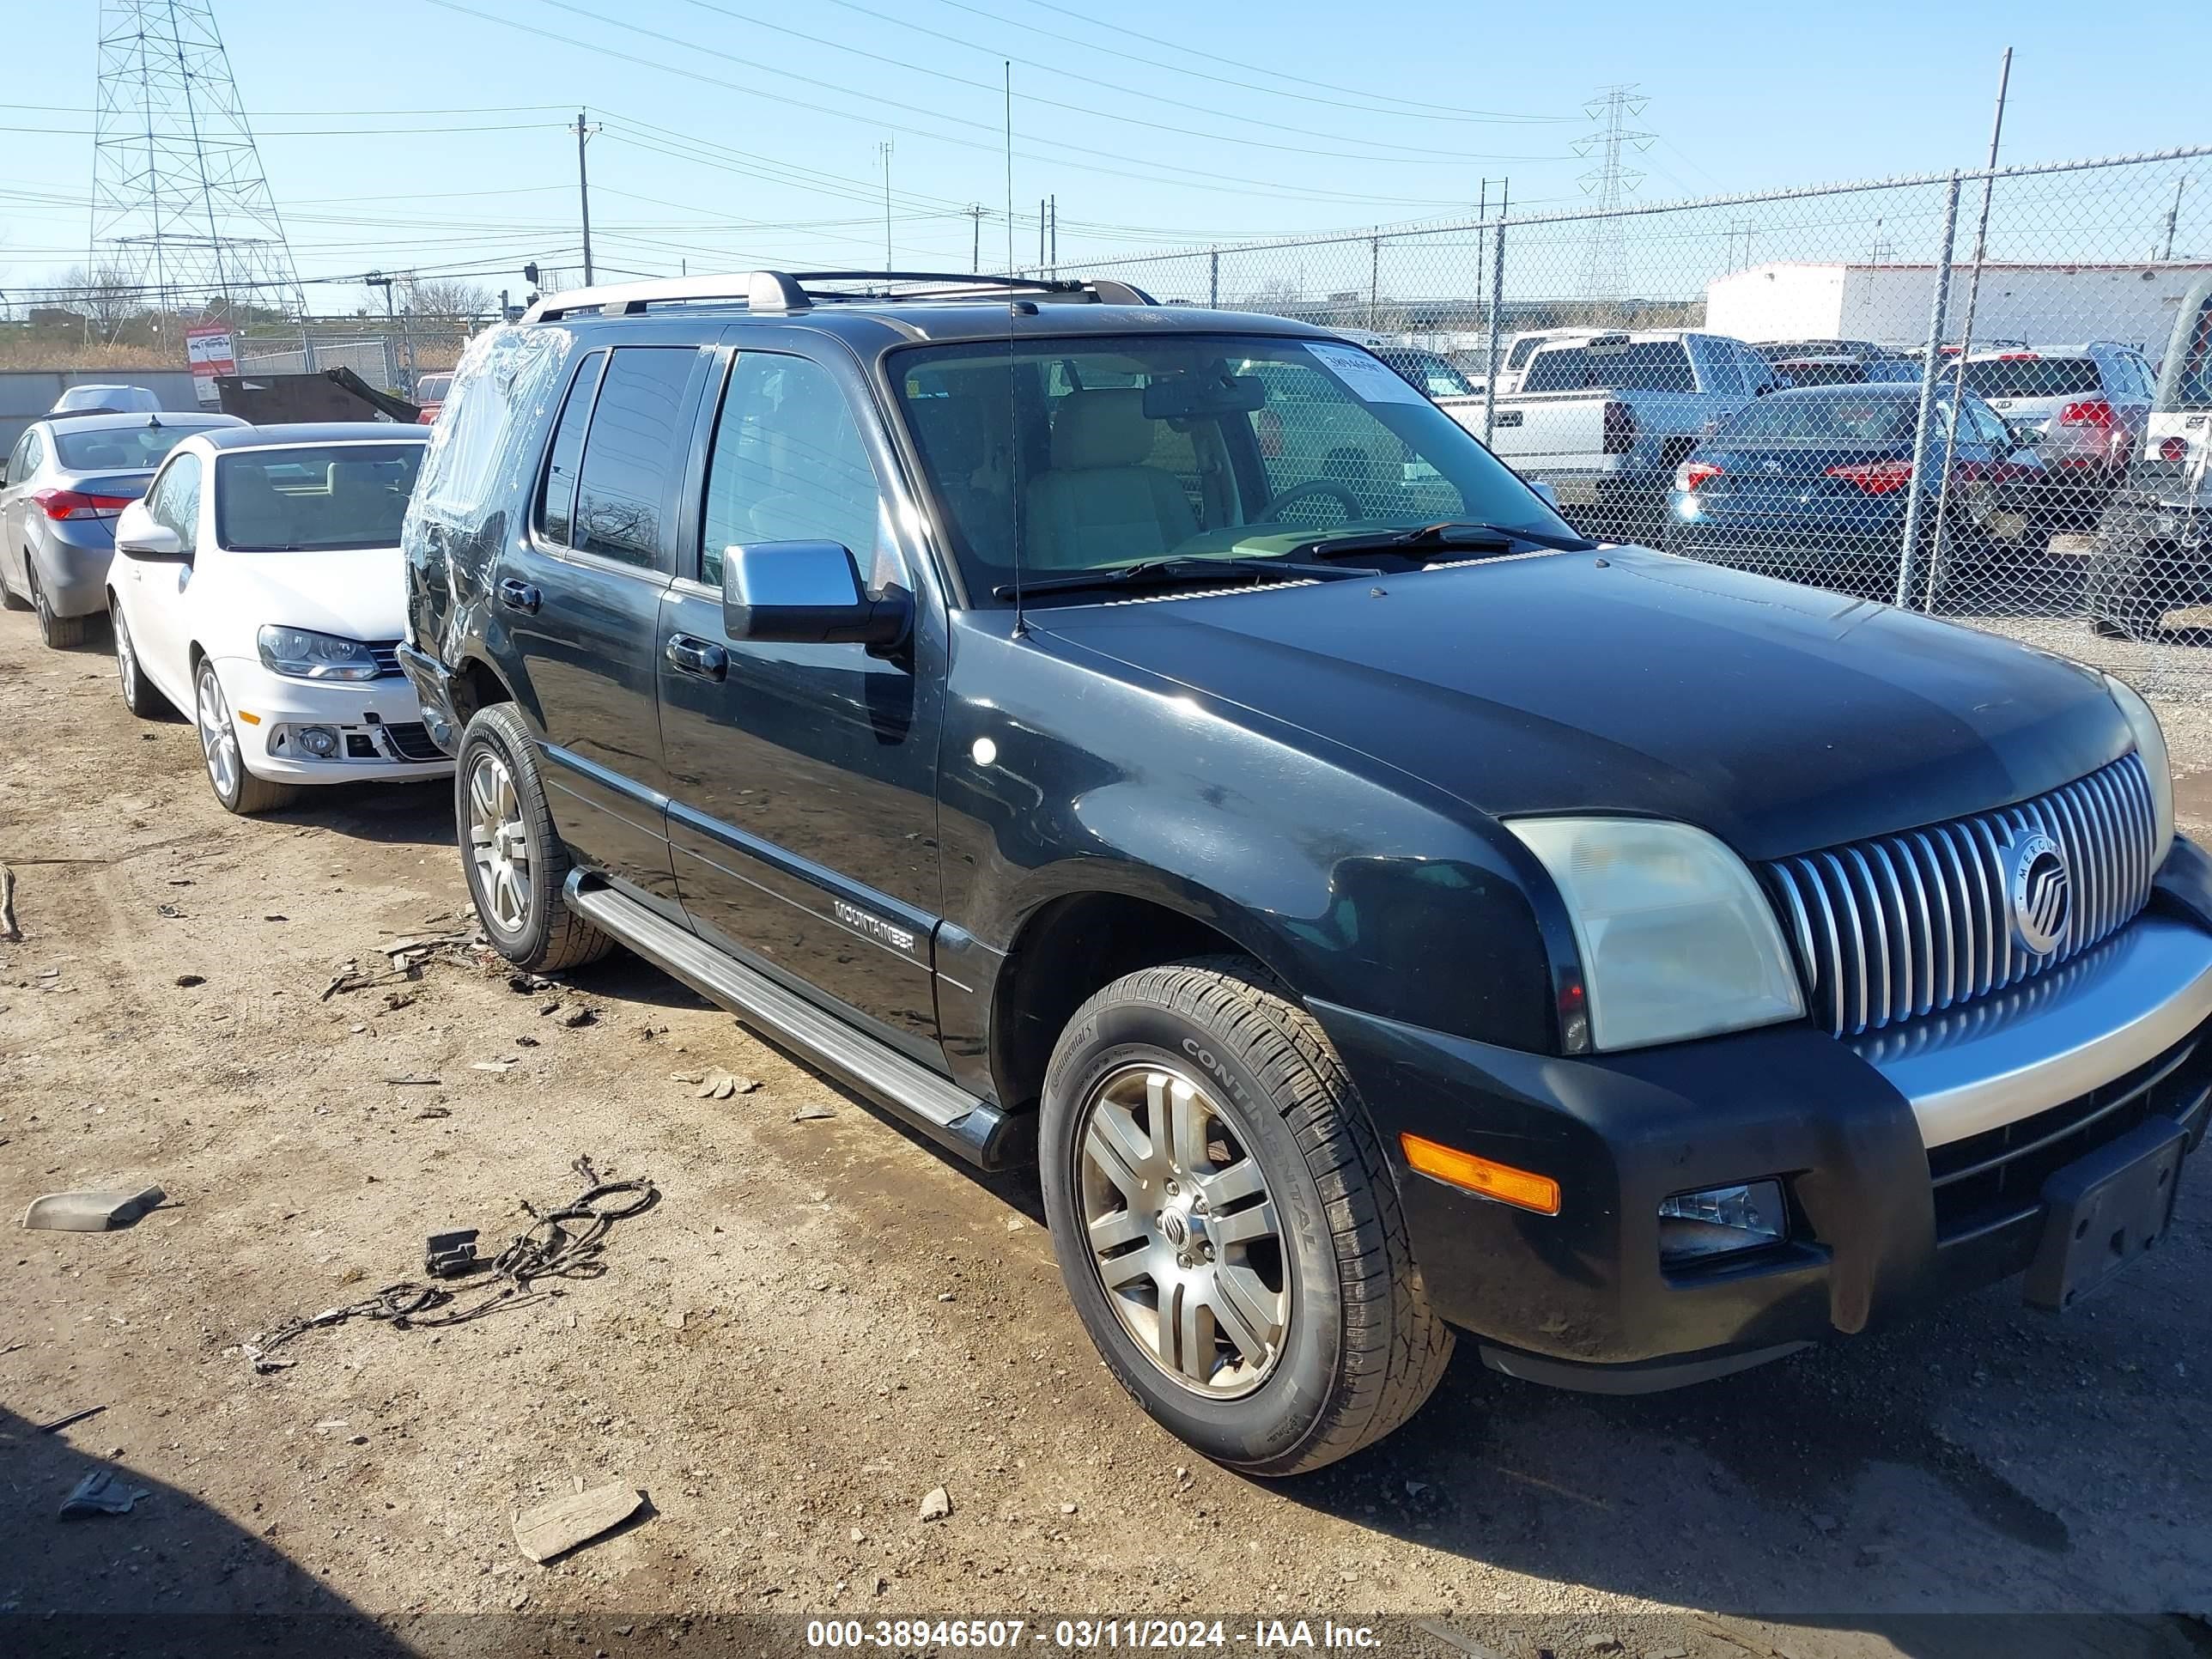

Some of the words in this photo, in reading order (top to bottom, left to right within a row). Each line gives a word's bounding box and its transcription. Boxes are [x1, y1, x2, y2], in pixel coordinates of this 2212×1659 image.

[471, 727, 516, 784] CONTINENTAL
[2019, 840, 2063, 880] MERCUR
[834, 901, 916, 955] MOUNTAINEER
[1051, 1027, 1087, 1088] Continental
[1182, 1037, 1317, 1254] CONTINENTAL
